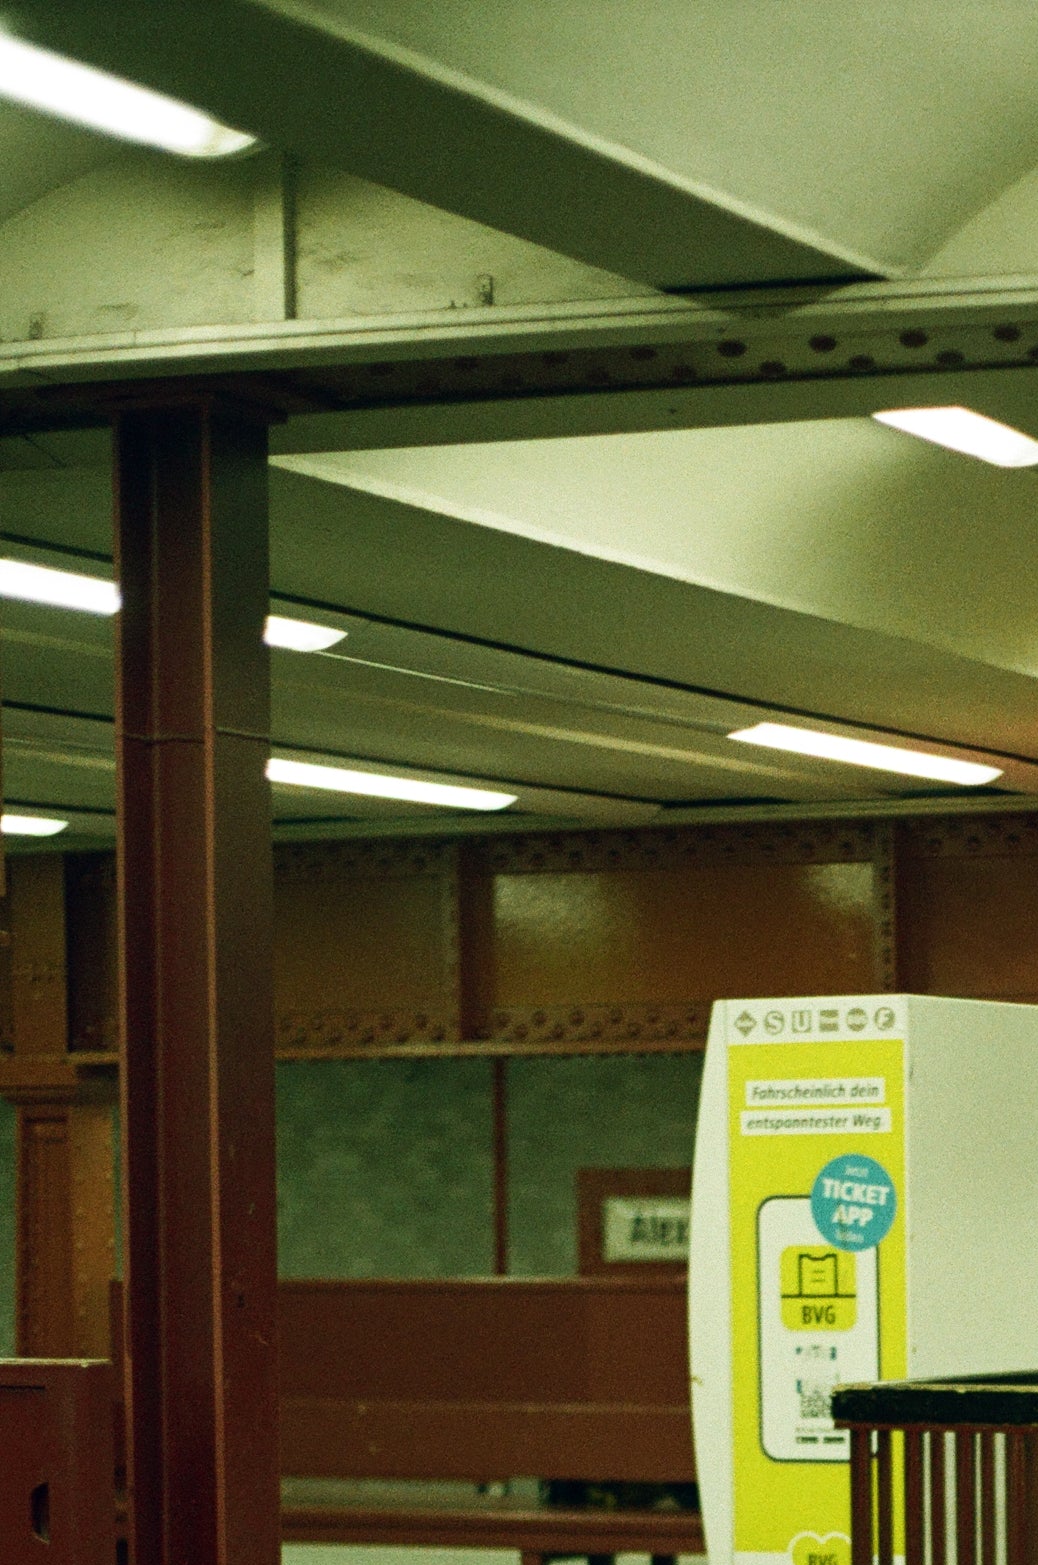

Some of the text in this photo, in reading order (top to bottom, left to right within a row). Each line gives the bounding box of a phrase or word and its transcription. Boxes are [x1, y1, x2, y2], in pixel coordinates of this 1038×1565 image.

[752, 1082, 879, 1100] Fahrscheinlich dein
[747, 1116, 848, 1130] entspanntester
[822, 1178, 890, 1206] TICKET
[832, 1204, 873, 1227] APP
[801, 1305, 836, 1325] BVG
